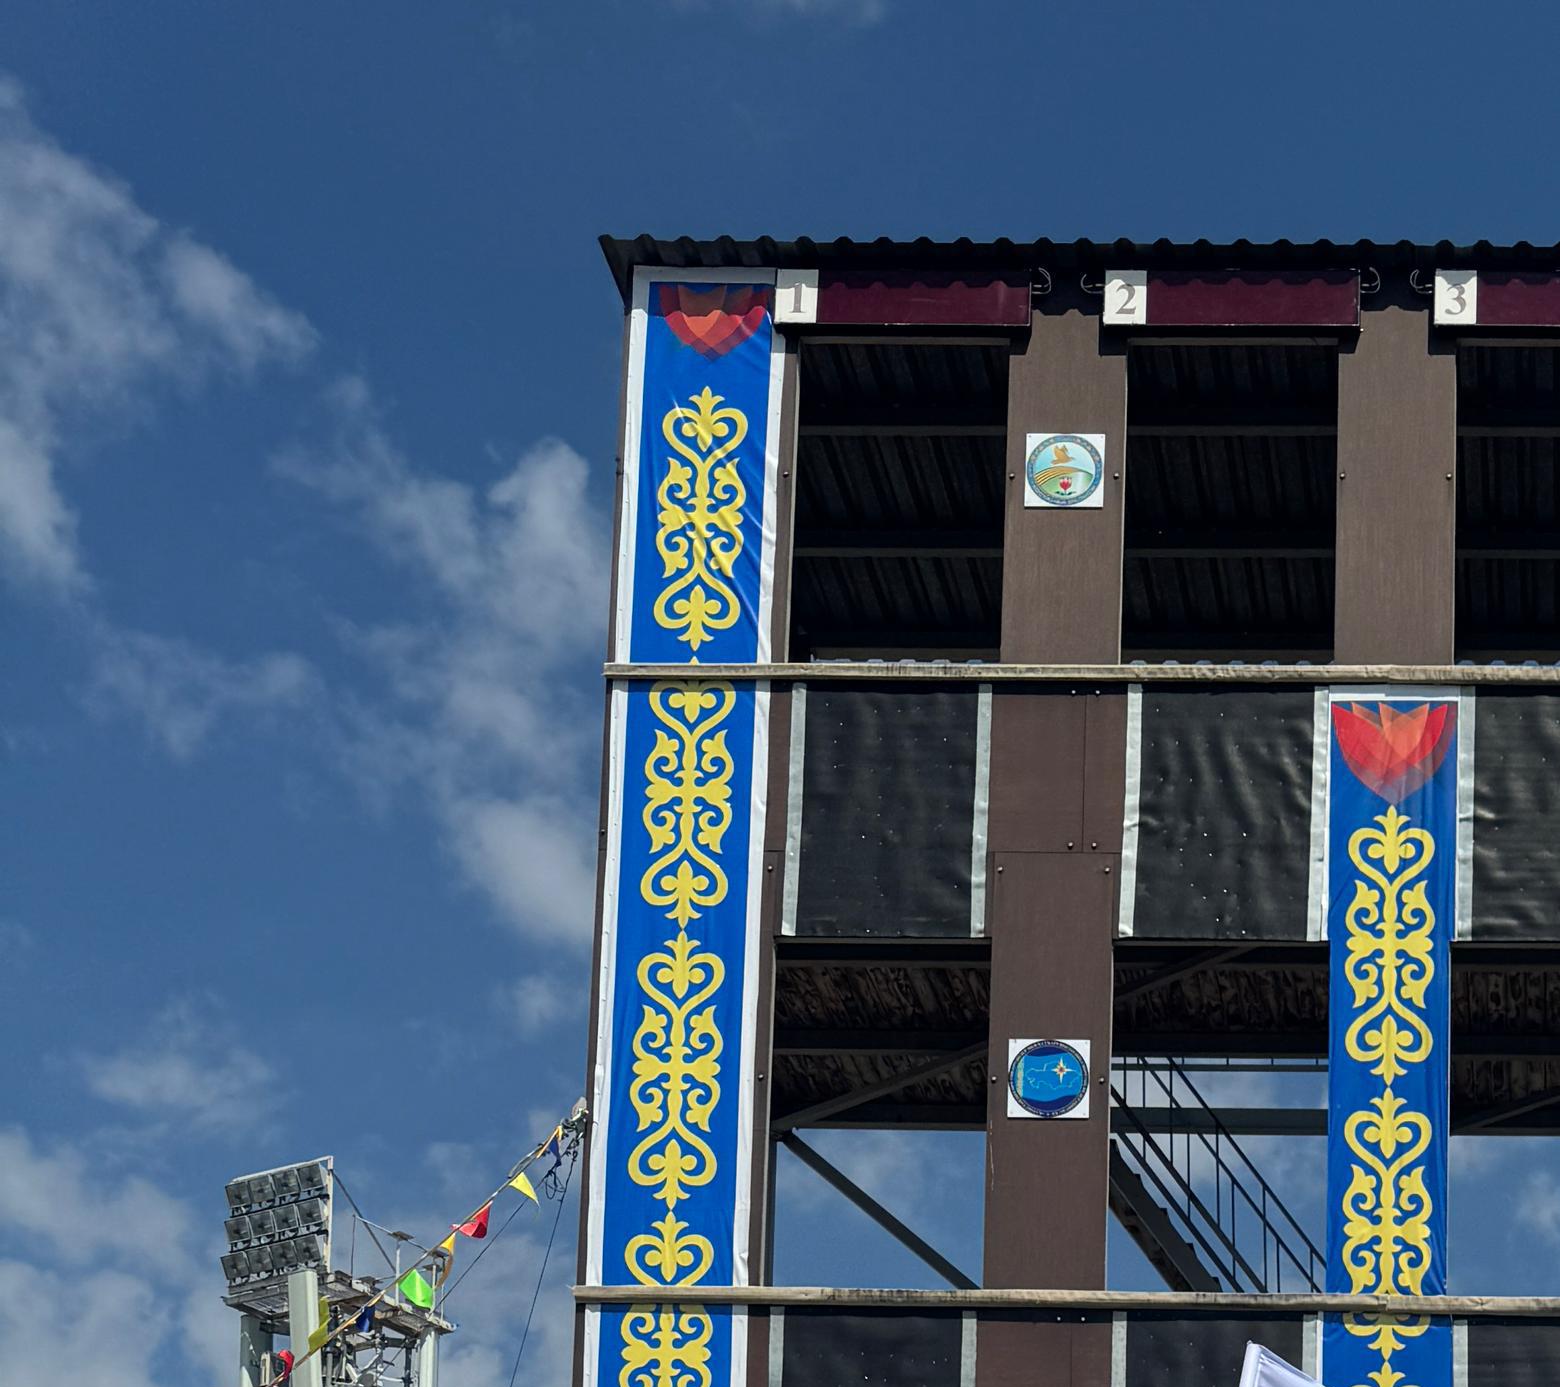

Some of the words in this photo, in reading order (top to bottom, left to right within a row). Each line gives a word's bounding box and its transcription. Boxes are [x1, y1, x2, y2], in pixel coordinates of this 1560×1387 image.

[789, 282, 804, 313] 1
[1115, 284, 1137, 315] 2
[1444, 283, 1467, 315] 3
